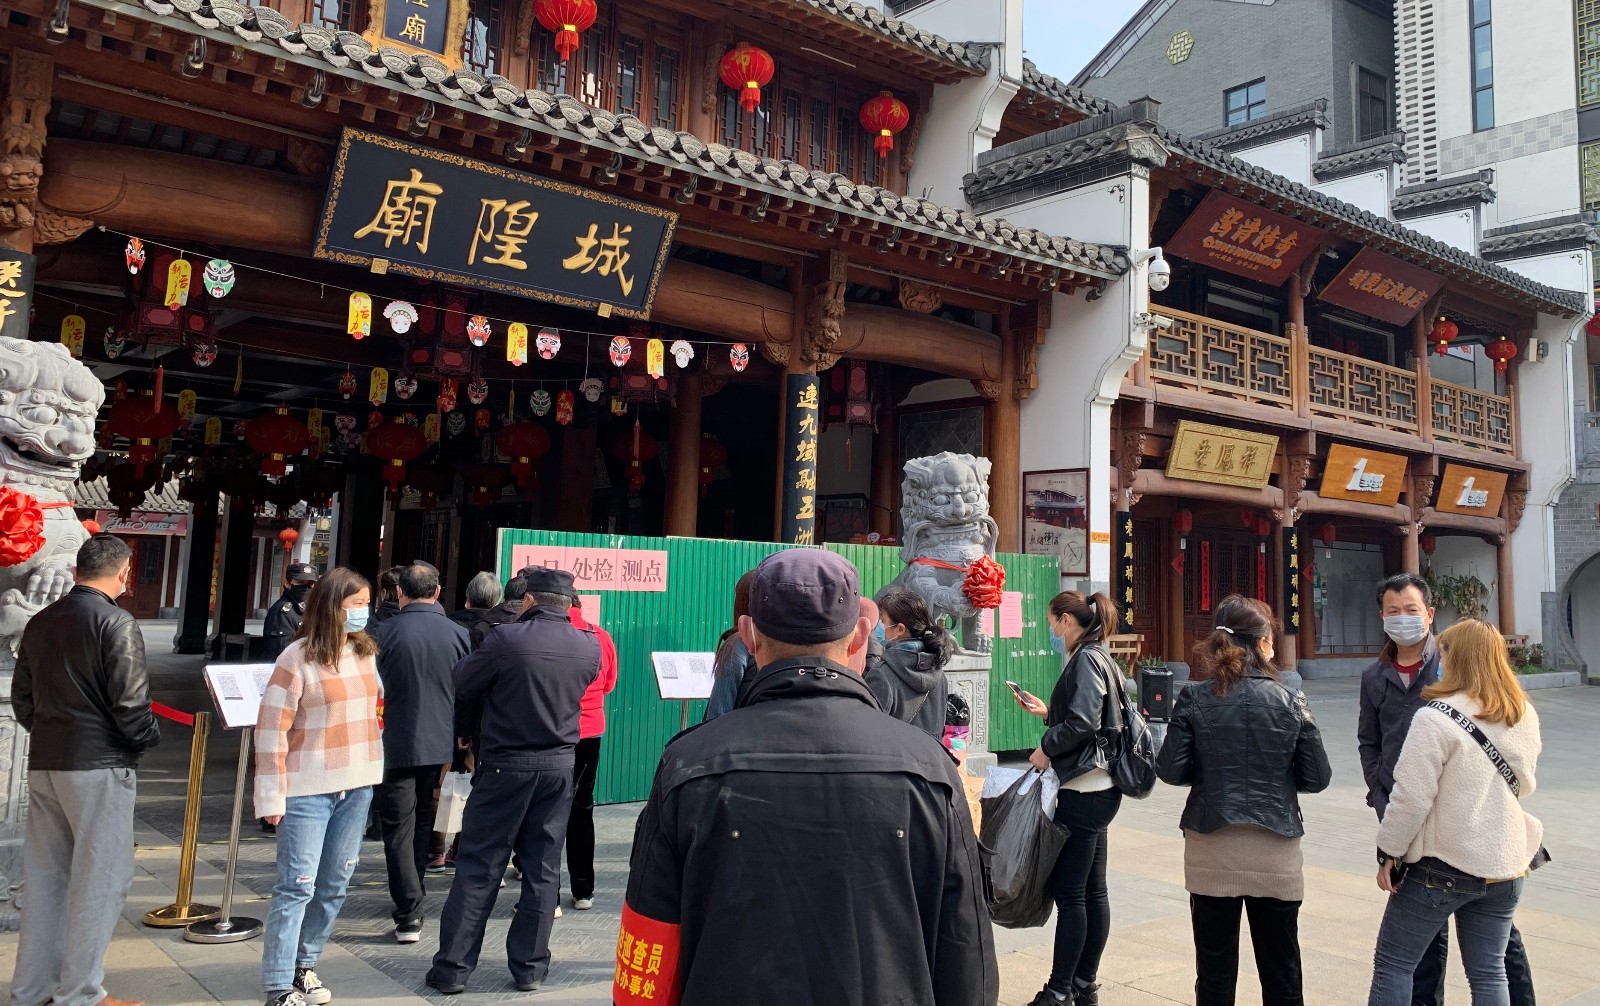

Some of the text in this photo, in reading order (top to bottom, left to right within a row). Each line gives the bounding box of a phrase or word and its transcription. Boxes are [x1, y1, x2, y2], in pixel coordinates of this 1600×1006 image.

[1431, 701, 1452, 718] YOU
[1455, 713, 1476, 733] SEE
[1482, 740, 1501, 765] LOVE
[1498, 763, 1514, 782] YOU
